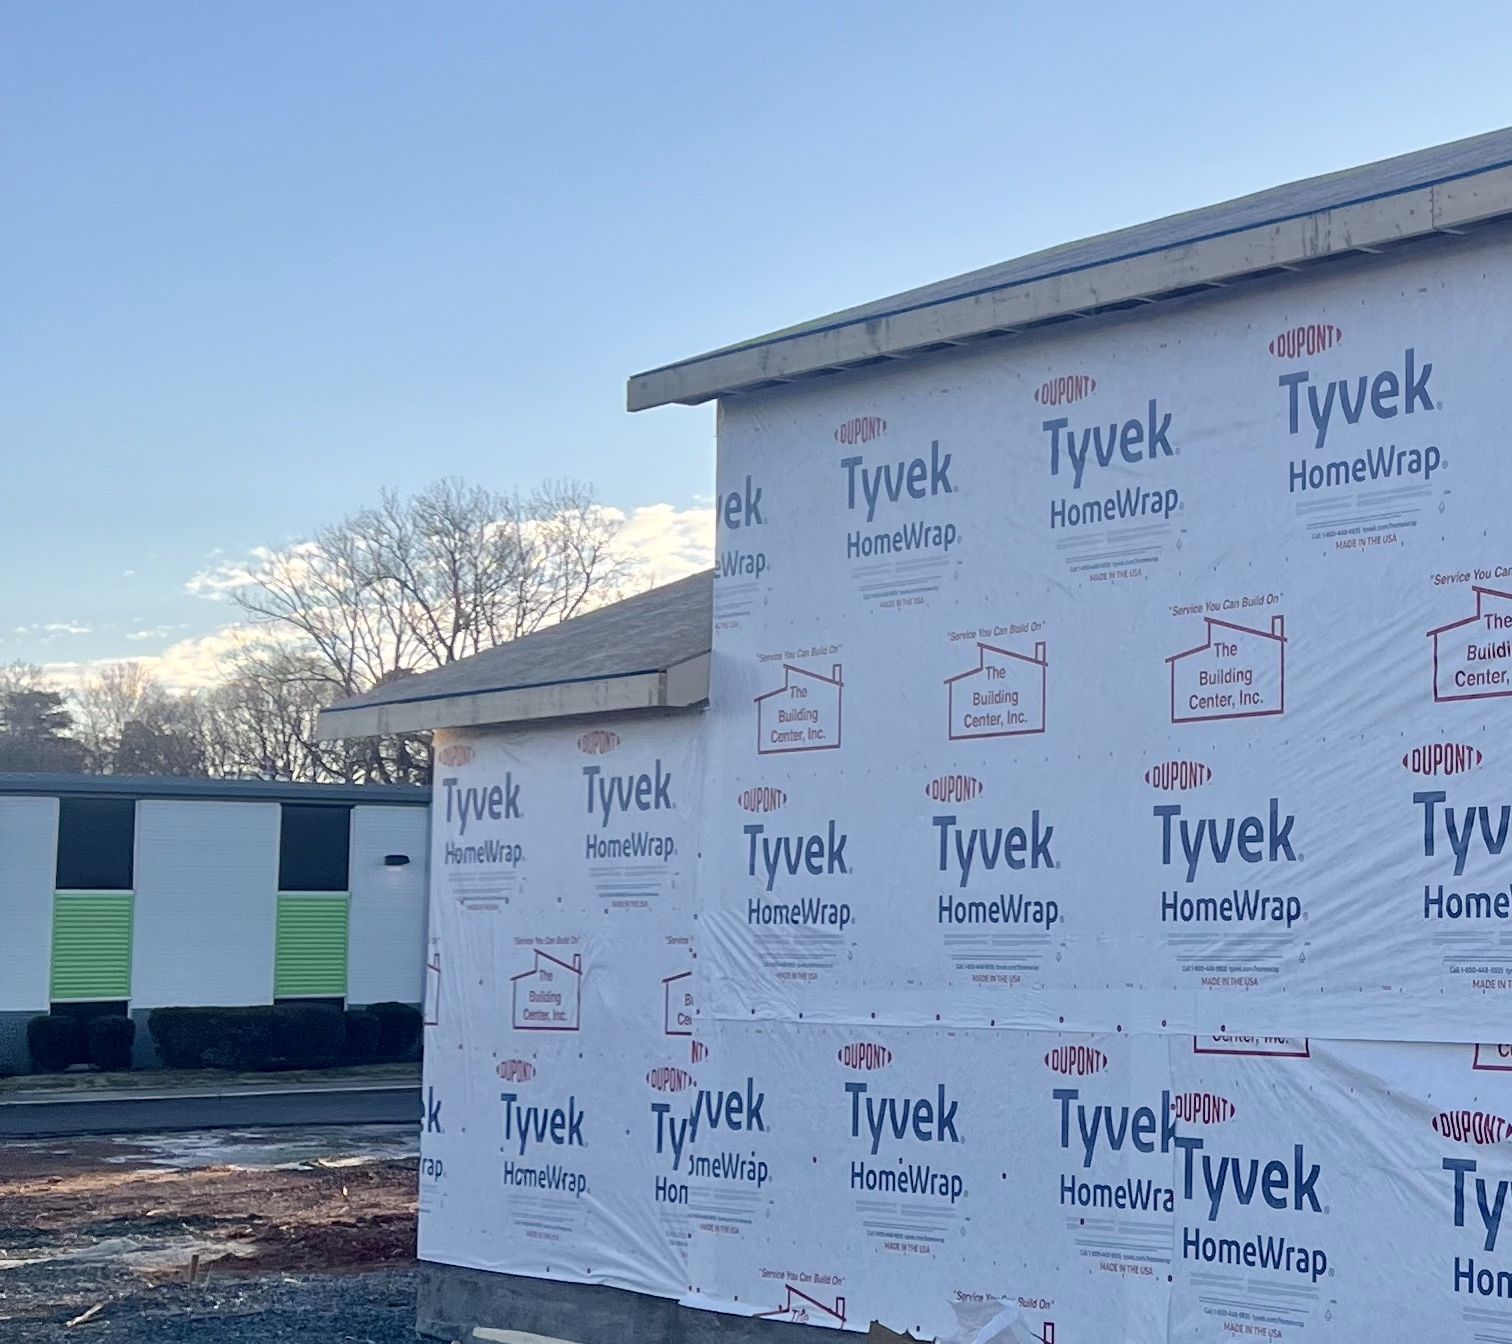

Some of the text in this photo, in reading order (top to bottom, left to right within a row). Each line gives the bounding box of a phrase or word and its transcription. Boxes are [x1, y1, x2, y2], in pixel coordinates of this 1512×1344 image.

[1278, 325, 1334, 359] DUPONT
[1042, 375, 1090, 406] DUPONT
[1279, 348, 1434, 449] Tyvek
[840, 417, 882, 444] DUPONT
[1043, 398, 1174, 489] Tyvek
[841, 440, 952, 522] Tyvek
[1290, 445, 1440, 492] HomeWrap
[1050, 487, 1178, 529] HomeWrap
[848, 521, 956, 559] HomeWrap
[714, 551, 766, 579] eWrap
[1430, 572, 1470, 585] "Service
[1474, 569, 1491, 580] You
[1484, 613, 1512, 629] The
[1214, 643, 1237, 657] The
[986, 666, 1006, 679] The
[1200, 669, 1252, 687] Building
[1455, 667, 1510, 687] Center,
[973, 691, 1018, 706] Building
[1189, 691, 1263, 710] Center, Inc.
[964, 711, 1028, 728] Center, Inc.
[1153, 761, 1205, 790] DUPONT
[1412, 744, 1473, 775] DUPONT
[442, 772, 520, 835] Tyvek
[582, 759, 672, 827] Tyvek
[744, 787, 782, 812] DUPONT
[932, 775, 978, 802] DUPONT
[444, 840, 522, 867] HomeWrap
[586, 832, 673, 861] HomeWrap
[744, 820, 848, 891] Tyvek
[932, 810, 1054, 887] Tyvek
[1153, 798, 1297, 883] Tyvek
[748, 898, 850, 929] HomeWrap
[938, 894, 1059, 930] HomeWrap
[1162, 889, 1300, 928] HomeWrap
[1473, 980, 1496, 989] MADE
[1498, 980, 1506, 989] IN
[844, 1043, 887, 1070] DUPONT
[1051, 1047, 1100, 1075] DUPONT
[501, 1093, 584, 1155] Tyvek
[690, 1077, 765, 1143] yvek
[845, 1082, 959, 1155] Tyvek
[1176, 1093, 1228, 1123] DUPONT
[1440, 1110, 1505, 1144] DUPONT
[504, 1161, 586, 1198] HomeWrap
[688, 1152, 767, 1187] omeWrap
[851, 1161, 962, 1203] HomeWrap
[1175, 1137, 1323, 1221] Tyvek
[1060, 1175, 1174, 1212] HomeWra
[1183, 1227, 1327, 1283] HomeWrap
